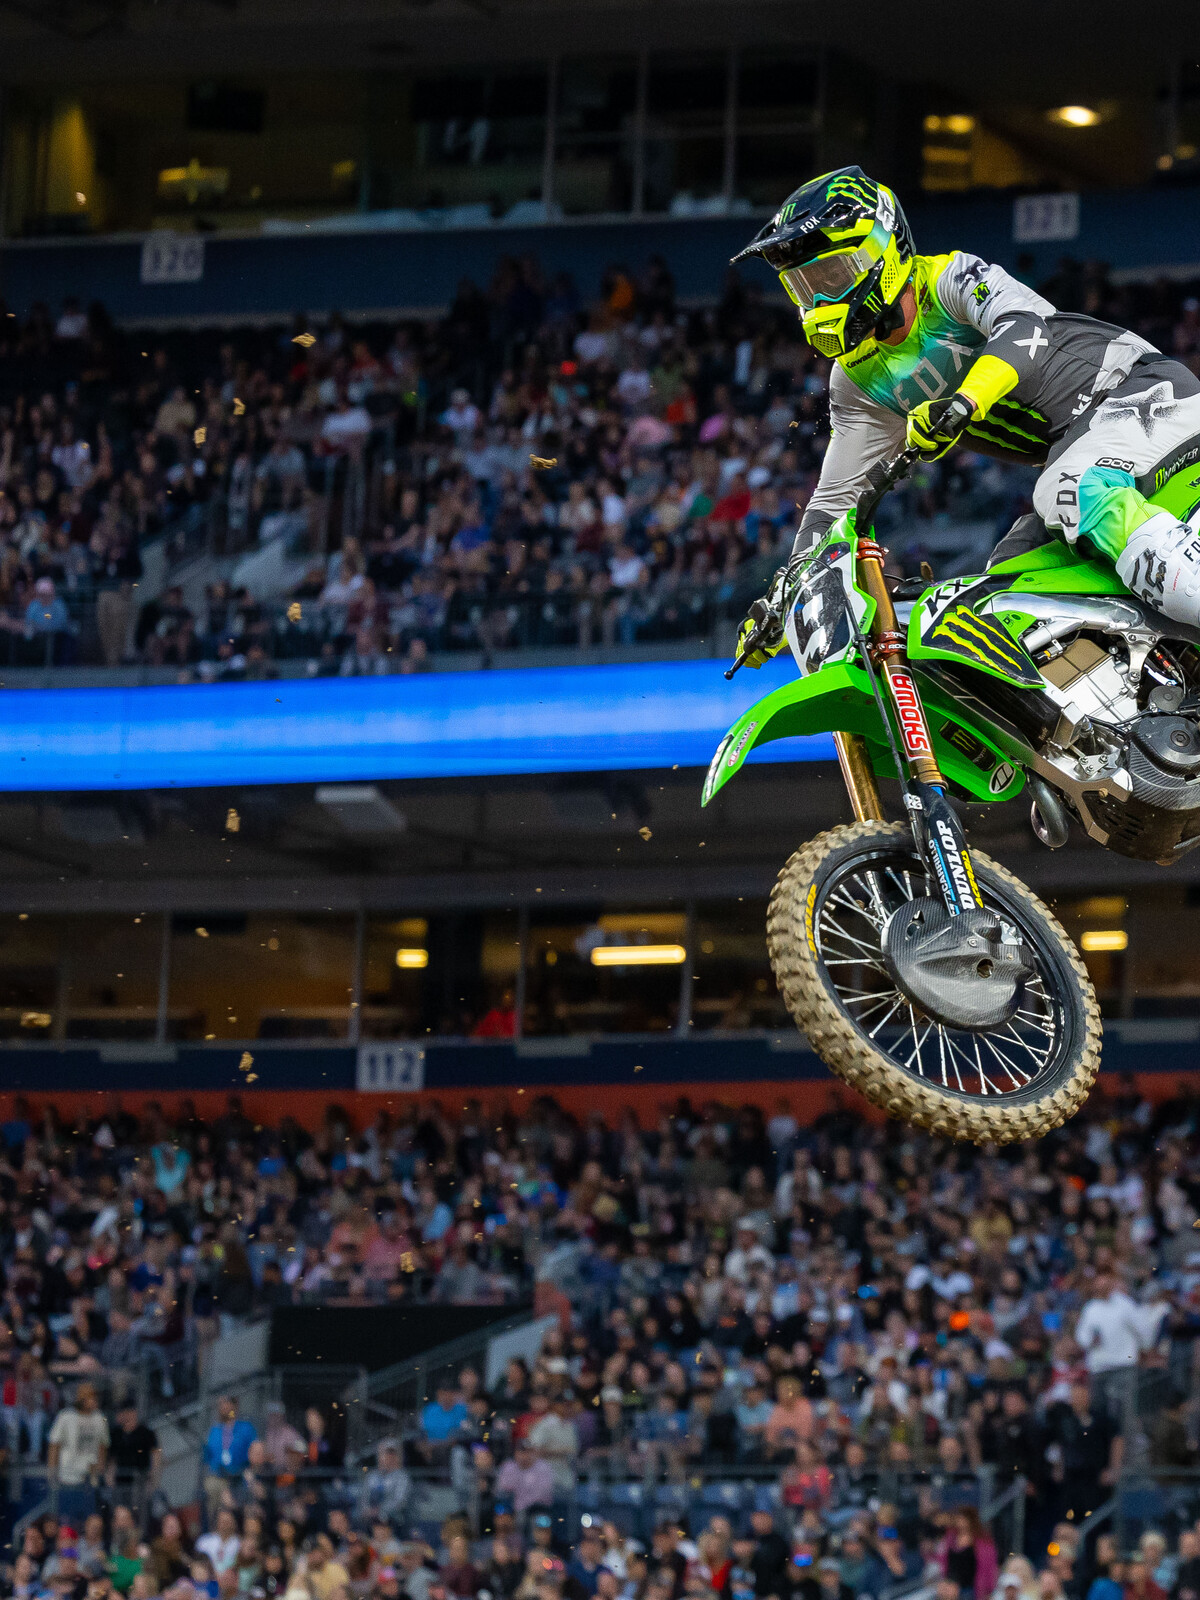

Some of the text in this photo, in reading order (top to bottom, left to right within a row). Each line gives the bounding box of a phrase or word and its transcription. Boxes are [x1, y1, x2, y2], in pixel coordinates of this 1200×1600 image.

[800, 216, 820, 234] FOX
[1056, 471, 1081, 528] FOX
[924, 579, 971, 618] KX
[892, 674, 929, 752] SHOWA
[936, 820, 976, 910] DUNLOP
[367, 1053, 415, 1084] 112
